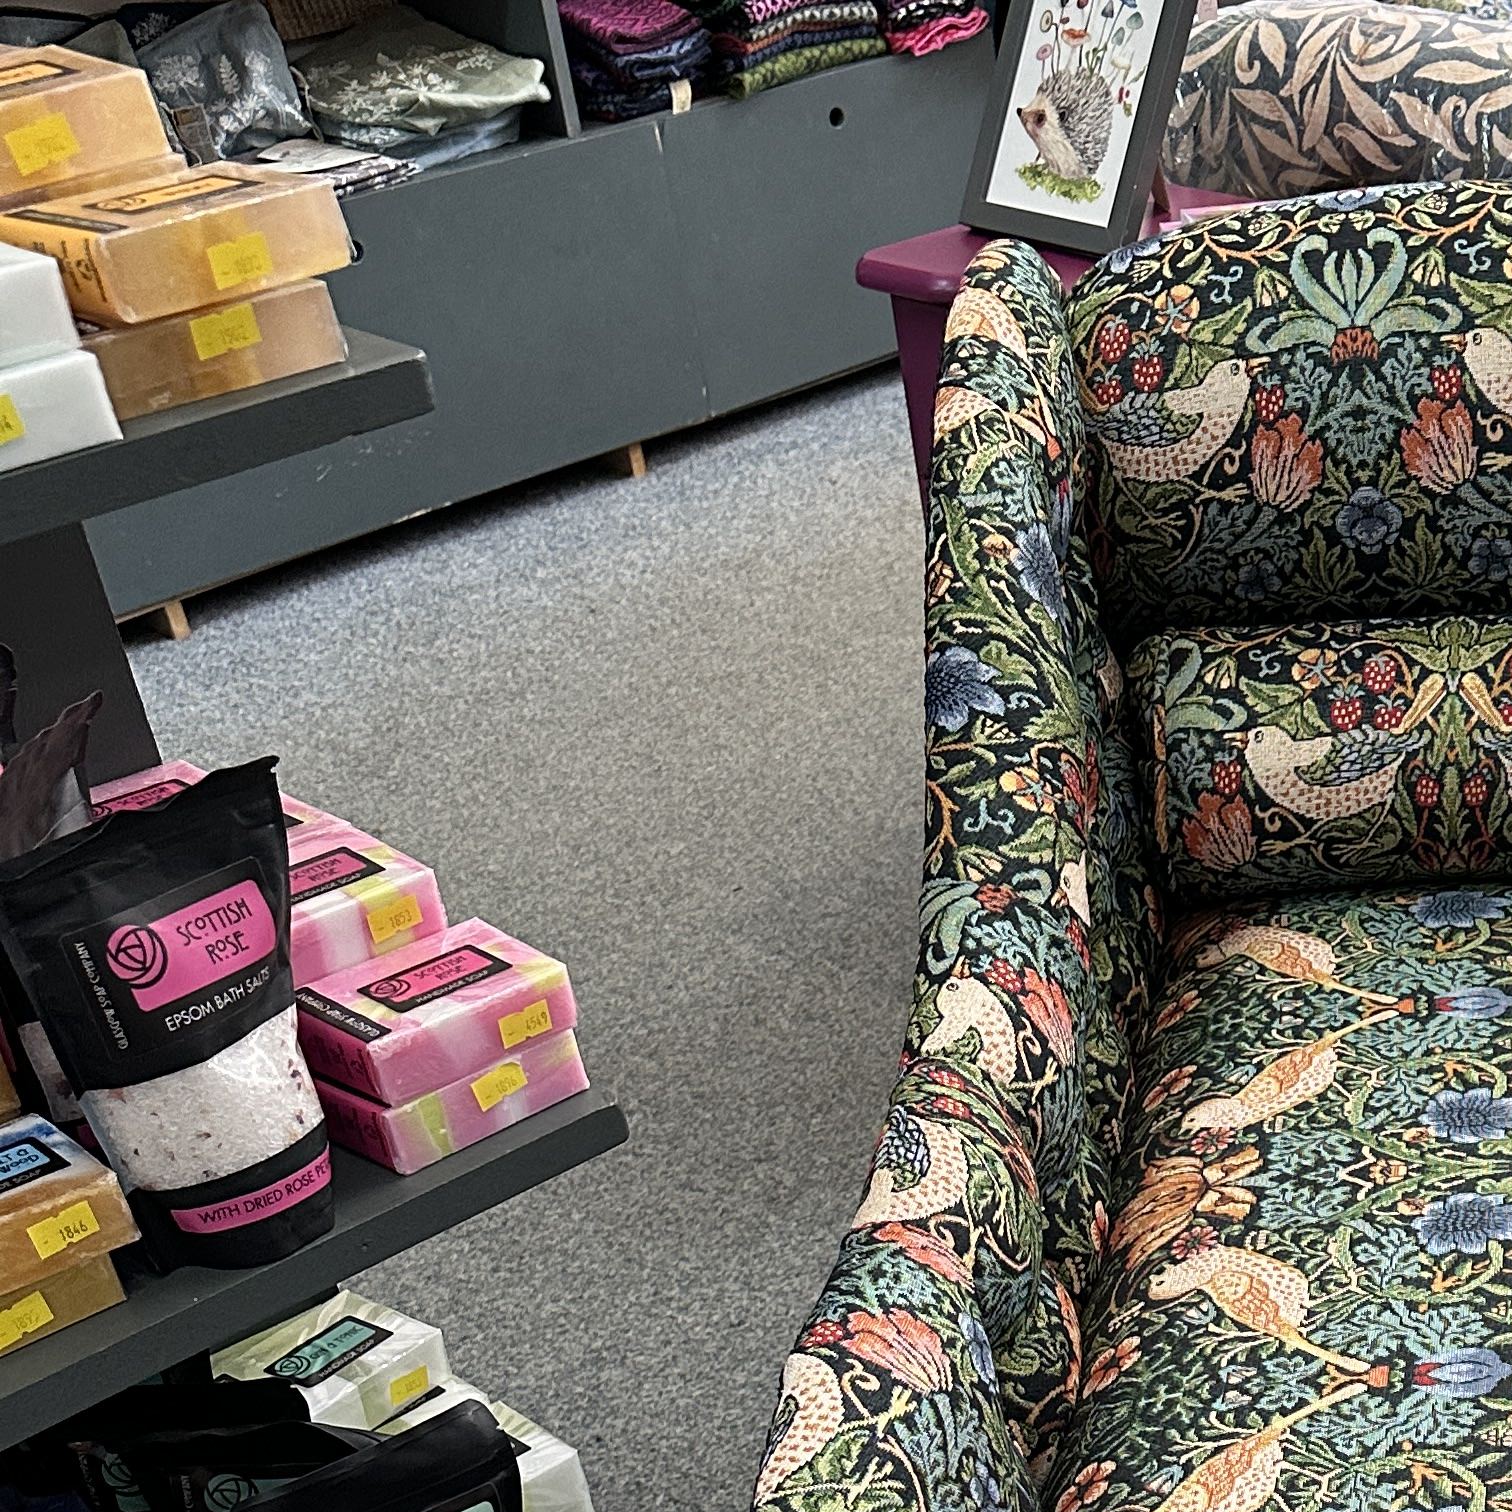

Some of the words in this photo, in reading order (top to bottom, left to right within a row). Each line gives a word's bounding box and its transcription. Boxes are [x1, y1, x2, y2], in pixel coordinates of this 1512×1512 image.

[177, 898, 252, 946] SCOTTISH
[74, 941, 101, 984] COMPANY
[205, 930, 249, 965] ROSE
[93, 984, 113, 1008] SOAP
[164, 1001, 215, 1032] EPSOM
[213, 984, 245, 1010] BATH
[246, 966, 270, 993] SALTS
[415, 979, 466, 1003] HANDMADE
[466, 970, 489, 985] SOAP
[104, 1003, 130, 1050] GLASGOW
[198, 1204, 241, 1224] WITH
[244, 1190, 283, 1214] DRIED
[285, 1170, 316, 1197] ROSE
[59, 1220, 88, 1242] 1846
